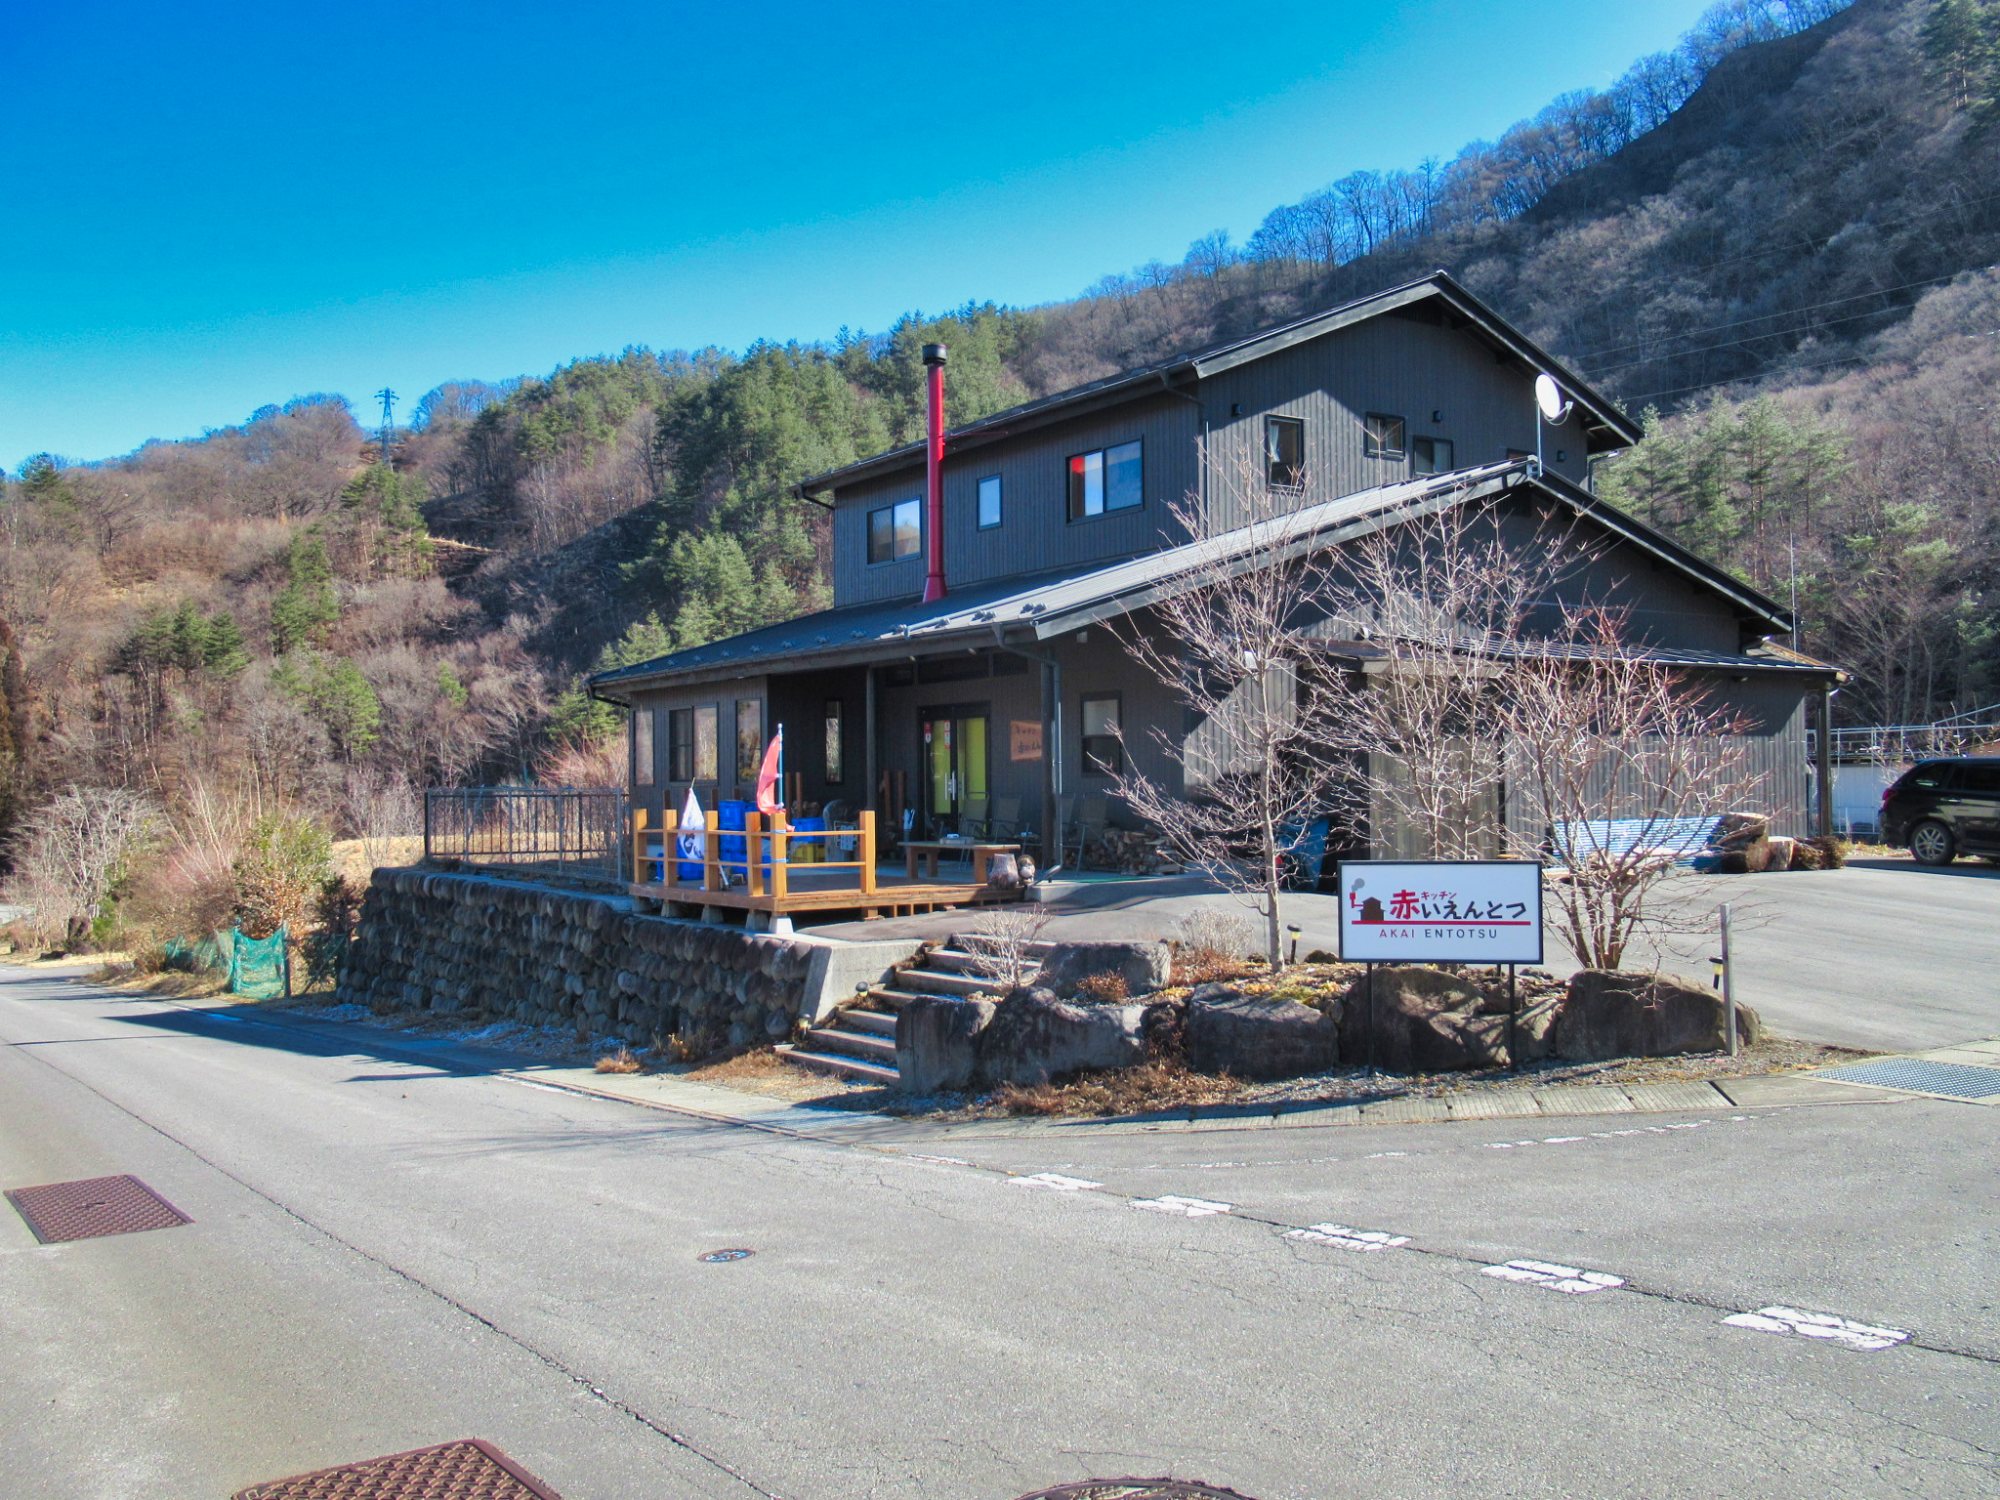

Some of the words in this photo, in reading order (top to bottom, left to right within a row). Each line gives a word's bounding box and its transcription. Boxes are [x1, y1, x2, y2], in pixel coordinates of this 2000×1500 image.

[1420, 890, 1457, 901] キッチン
[1390, 889, 1527, 920] 赤いえんとつ
[1379, 928, 1415, 939] AKAI
[1424, 928, 1497, 939] ENTOTSU
